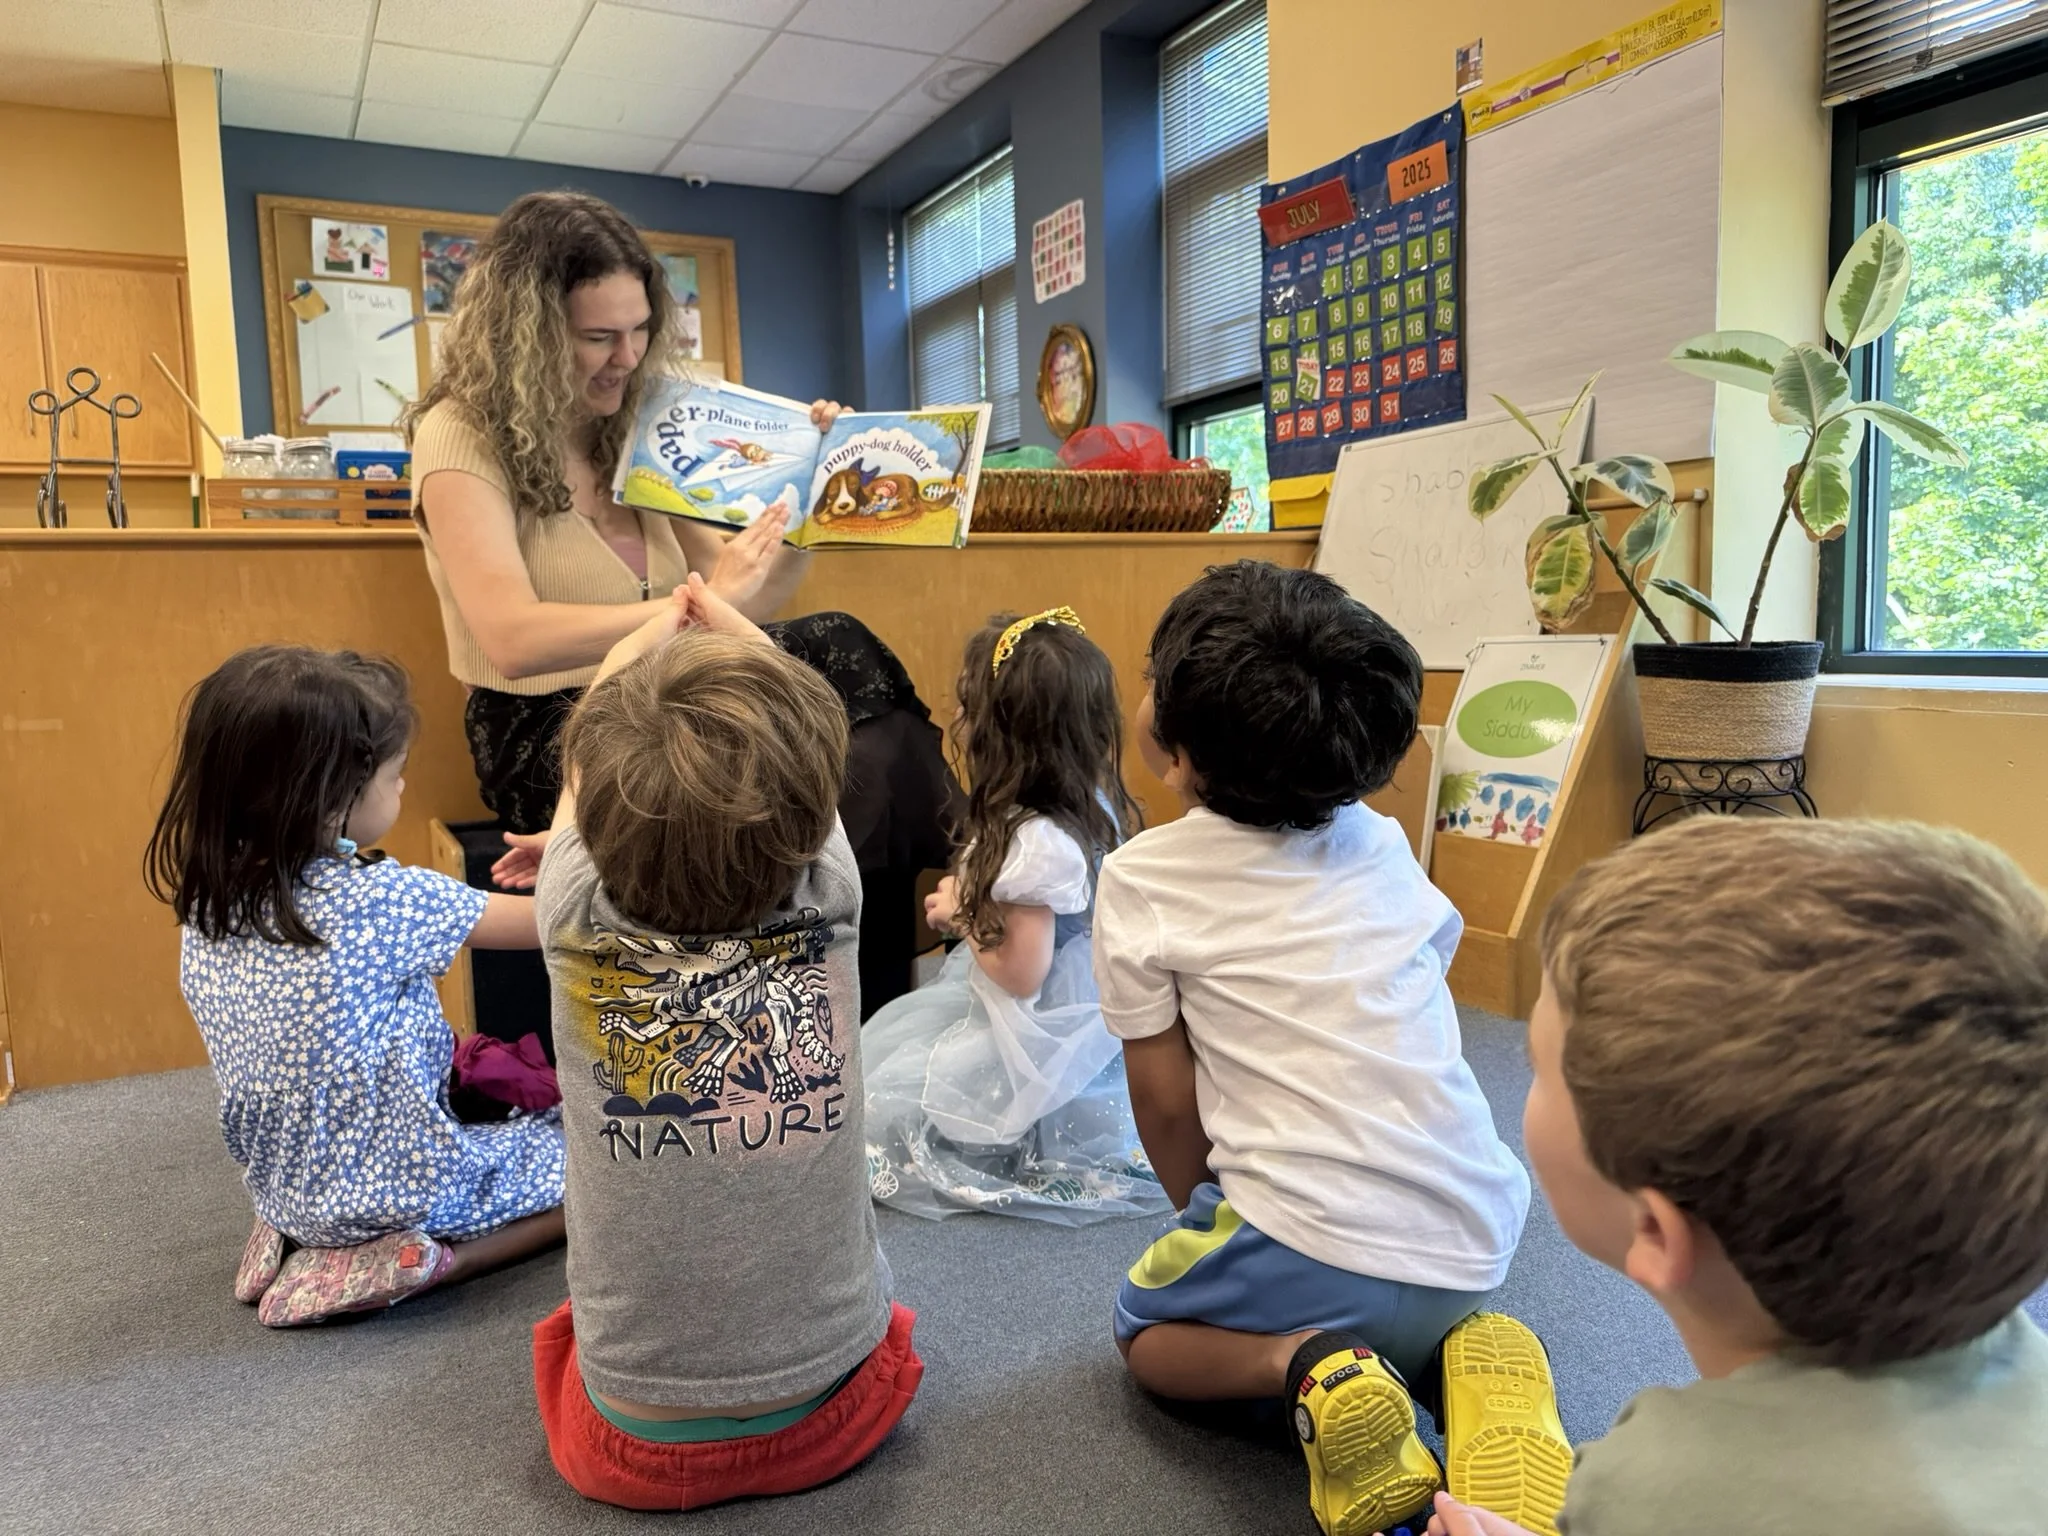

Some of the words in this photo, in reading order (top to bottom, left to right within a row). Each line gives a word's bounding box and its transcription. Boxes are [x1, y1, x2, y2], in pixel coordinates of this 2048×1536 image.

[1402, 158, 1431, 188] 2025
[1287, 200, 1320, 229] JULY
[1407, 224, 1426, 235] Friday
[1330, 274, 1337, 288] 1
[1356, 264, 1364, 281] 2
[1386, 253, 1395, 270] 3
[1412, 244, 1422, 261] 4
[1437, 236, 1445, 254] 5
[1272, 324, 1283, 339] 6
[1302, 316, 1311, 331] 7
[1333, 307, 1342, 323] 8
[1356, 302, 1365, 318] 9
[1382, 293, 1398, 310] 10
[1408, 285, 1423, 301] 11
[1437, 272, 1451, 291] 12
[1272, 354, 1288, 371] 13
[1301, 348, 1316, 361] 14
[1329, 341, 1344, 358] 15
[1355, 335, 1370, 353] 16
[1383, 327, 1399, 344] 17
[1407, 320, 1423, 338] 18
[1437, 308, 1452, 326] 19
[1272, 388, 1288, 404] 20
[1298, 378, 1314, 397] 21
[1328, 377, 1344, 392] 22
[1354, 371, 1370, 387] 23
[1384, 365, 1400, 381] 24
[1408, 357, 1425, 374] 25
[1440, 347, 1455, 364] 26
[1277, 420, 1293, 435] 27
[1299, 417, 1315, 432] 28
[1324, 409, 1340, 427] 29
[1353, 406, 1369, 423] 30
[1382, 399, 1399, 416] 31
[656, 405, 752, 478] paper-plane
[754, 421, 790, 432] folder
[823, 438, 892, 475] puppy-dog
[892, 440, 932, 472] holder
[1504, 695, 1535, 716] My
[600, 1093, 845, 1162] NATURE
[1323, 1363, 1360, 1387] crocs
[1487, 1398, 1532, 1411] crocs
